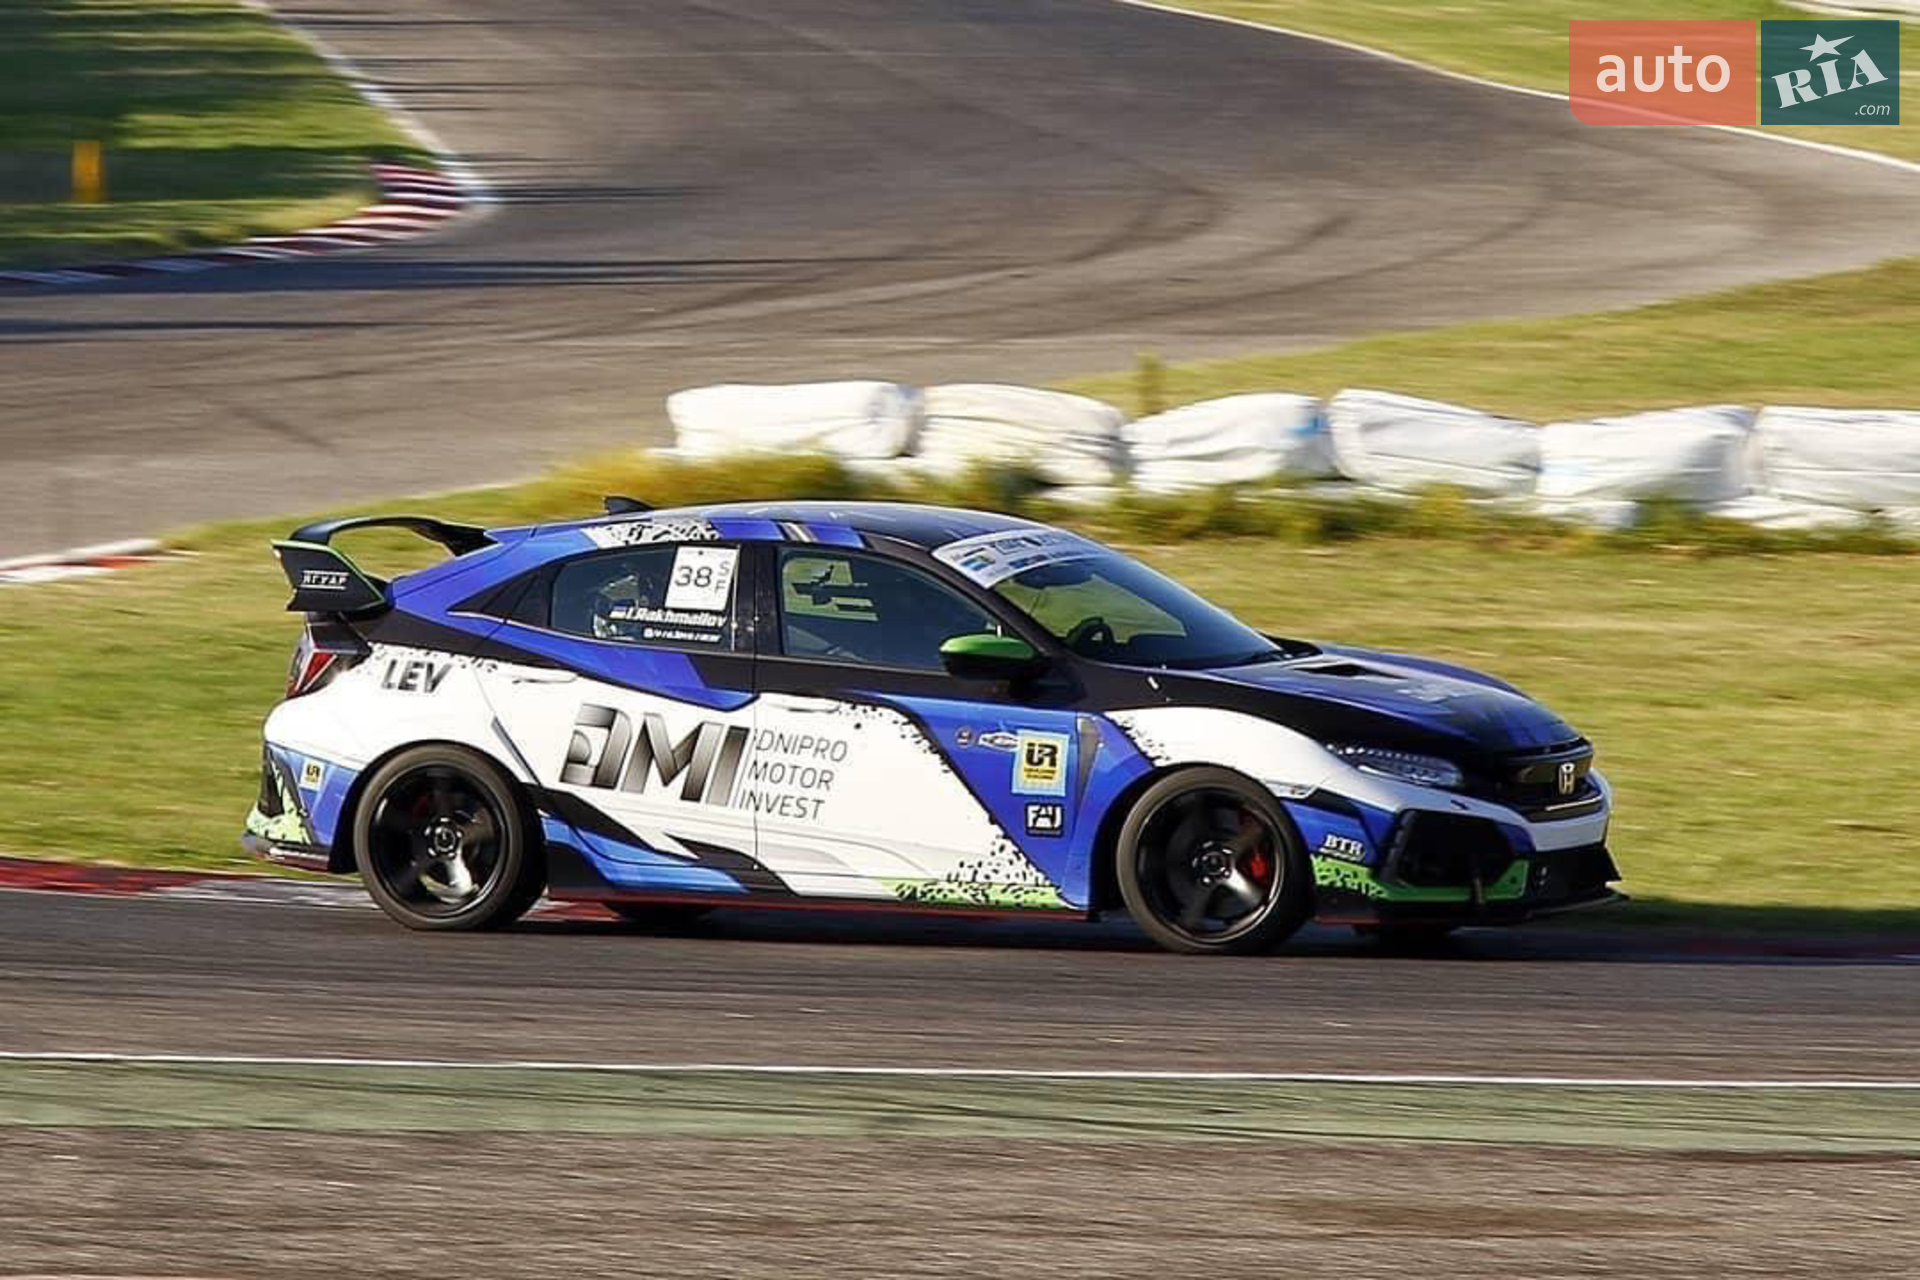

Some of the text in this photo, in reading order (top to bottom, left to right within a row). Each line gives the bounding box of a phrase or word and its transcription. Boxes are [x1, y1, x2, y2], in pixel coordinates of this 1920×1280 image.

[673, 566, 713, 588] 38
[380, 659, 453, 693] LEV
[559, 702, 751, 807] DMI
[756, 728, 848, 762] DNIPRO
[748, 759, 835, 791] MOTOR
[738, 789, 826, 820] INVEST
